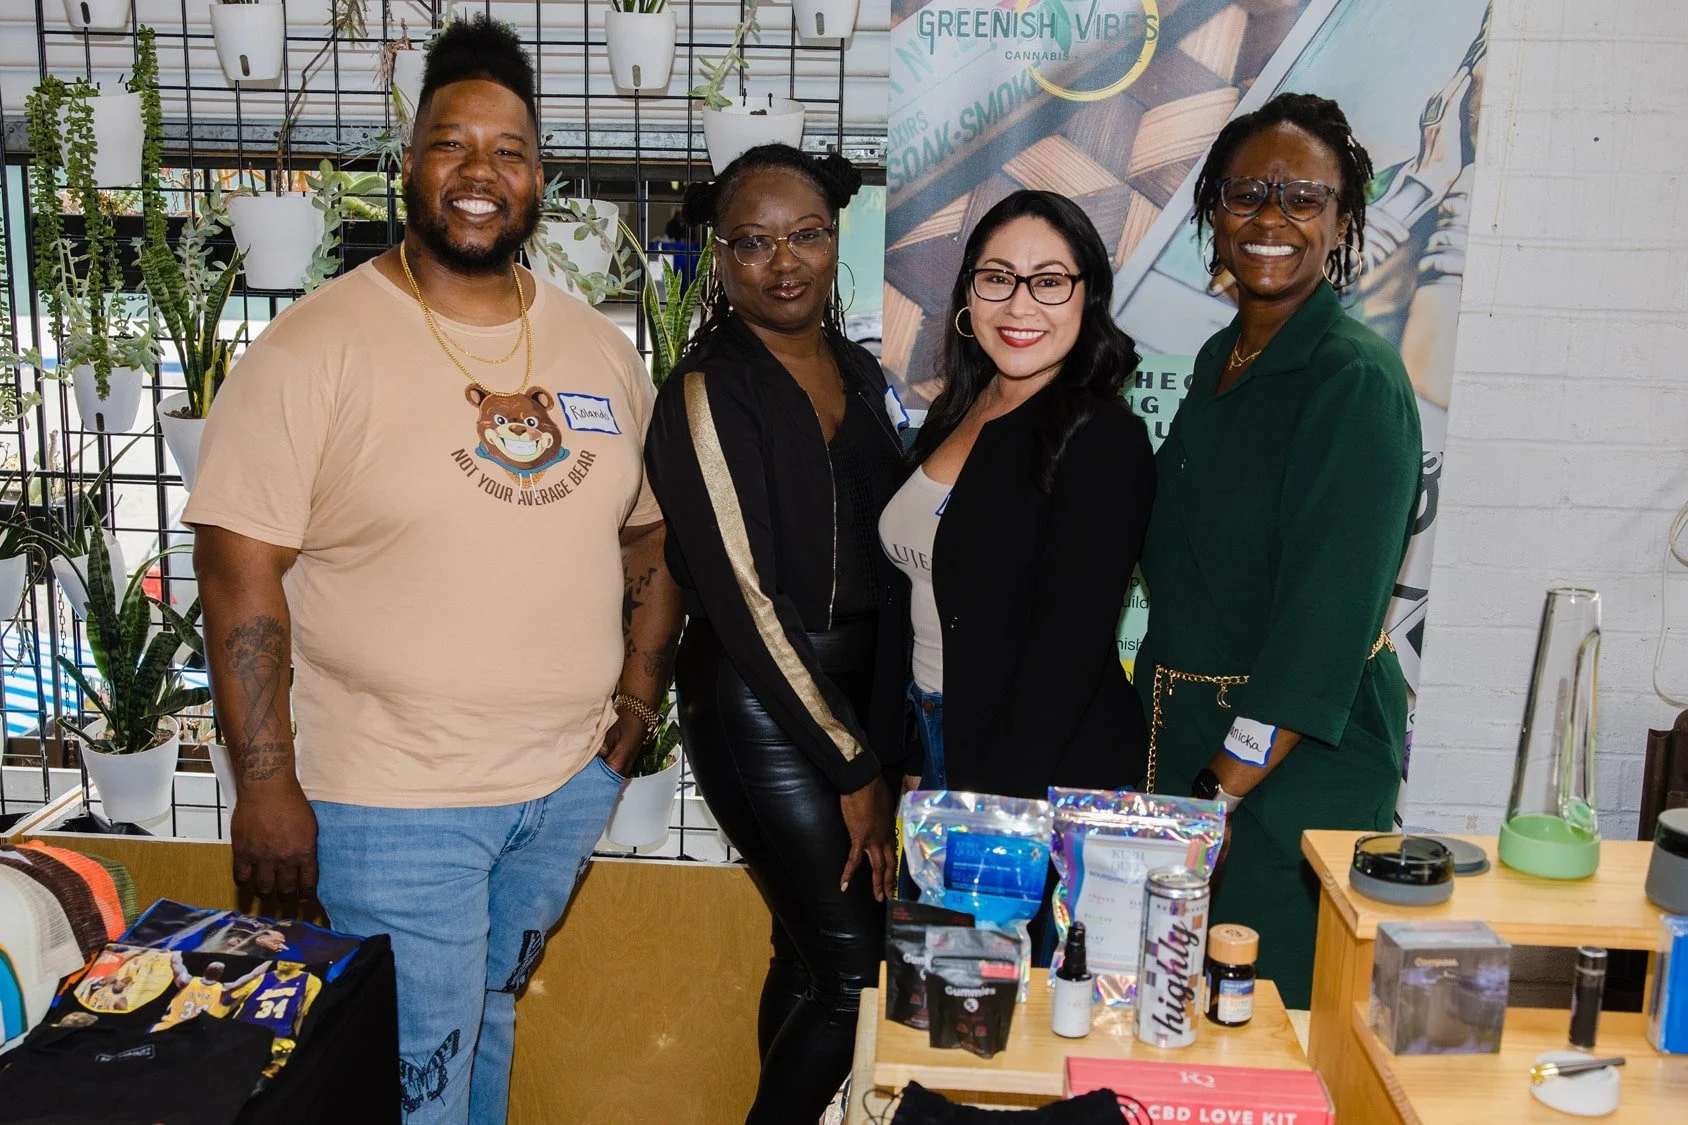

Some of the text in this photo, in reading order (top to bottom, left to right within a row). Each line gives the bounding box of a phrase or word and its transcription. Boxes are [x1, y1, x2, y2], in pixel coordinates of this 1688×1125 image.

[917, 8, 1057, 56] GREENISH
[1074, 0, 1159, 44] VIBES
[1004, 50, 1069, 61] CANNABIS
[451, 448, 597, 507] NOT YOUR AVERAGE BEAR
[1152, 920, 1200, 1035] highly
[254, 999, 290, 1019] 34
[1148, 1104, 1191, 1122] CBD
[1199, 1108, 1254, 1125] LOVE
[1261, 1111, 1299, 1125] KIT
